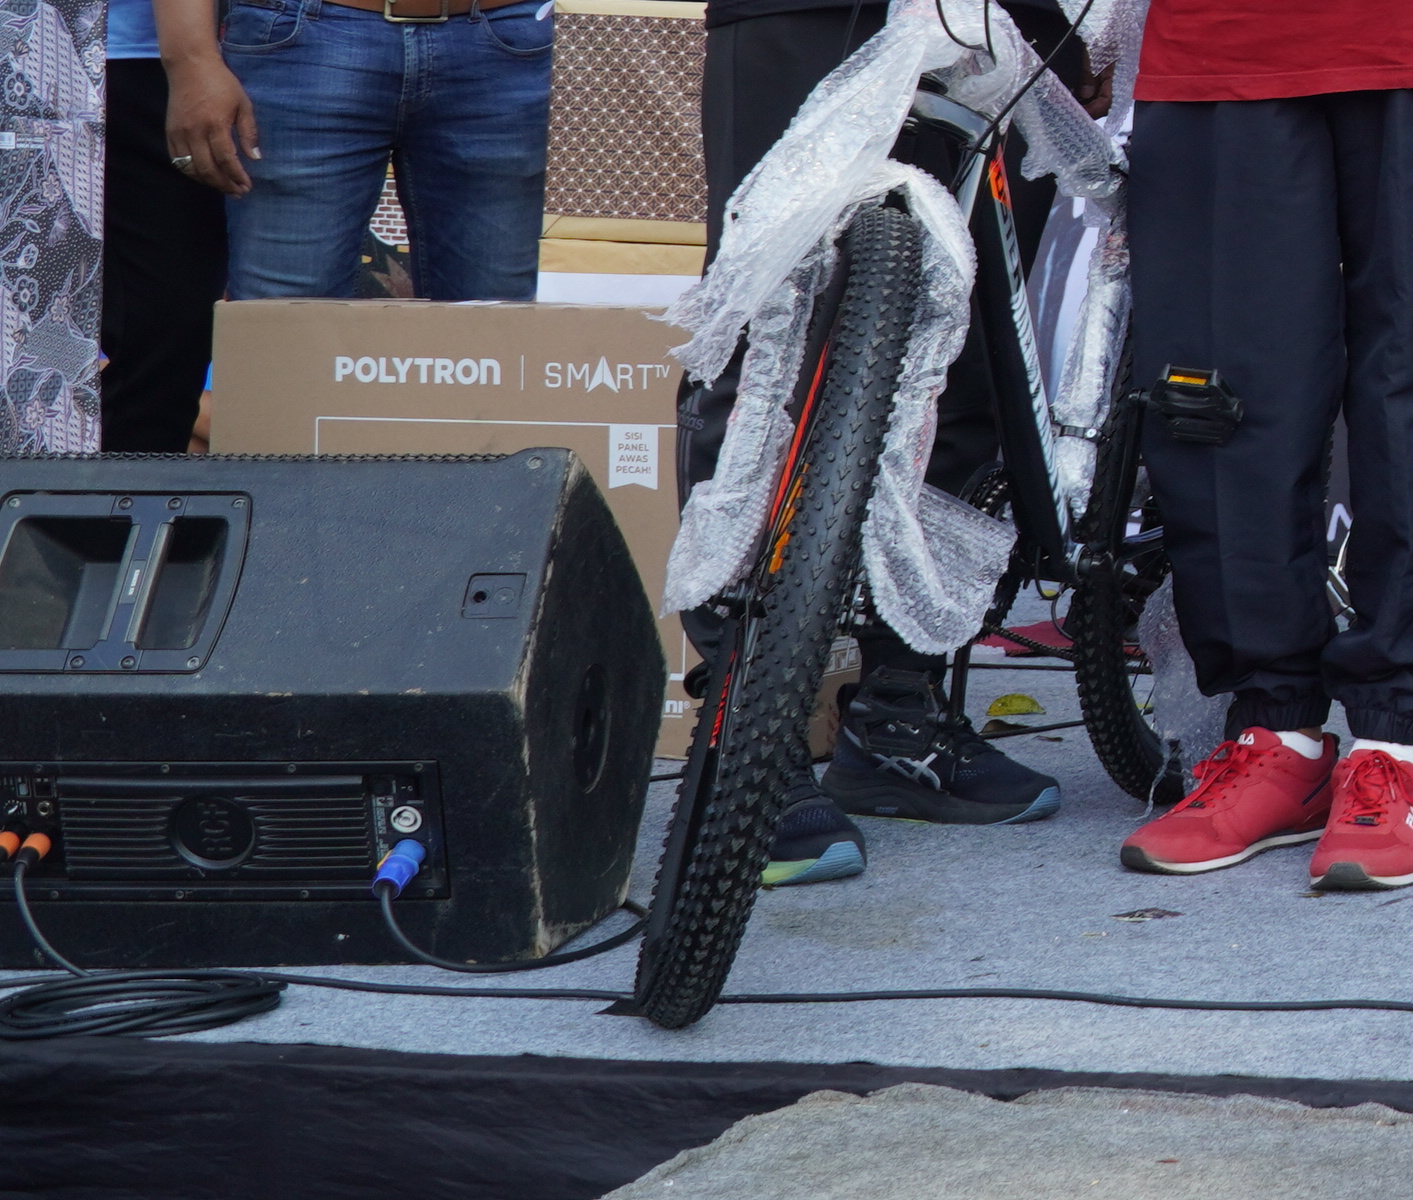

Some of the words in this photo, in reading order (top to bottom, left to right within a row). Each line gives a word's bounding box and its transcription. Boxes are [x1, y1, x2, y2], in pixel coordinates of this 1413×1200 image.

[335, 356, 501, 386] POLYTRON
[625, 432, 642, 440] SISI
[618, 443, 650, 451] PANEL
[618, 455, 649, 463] AWAS
[616, 466, 651, 474] PECAH!
